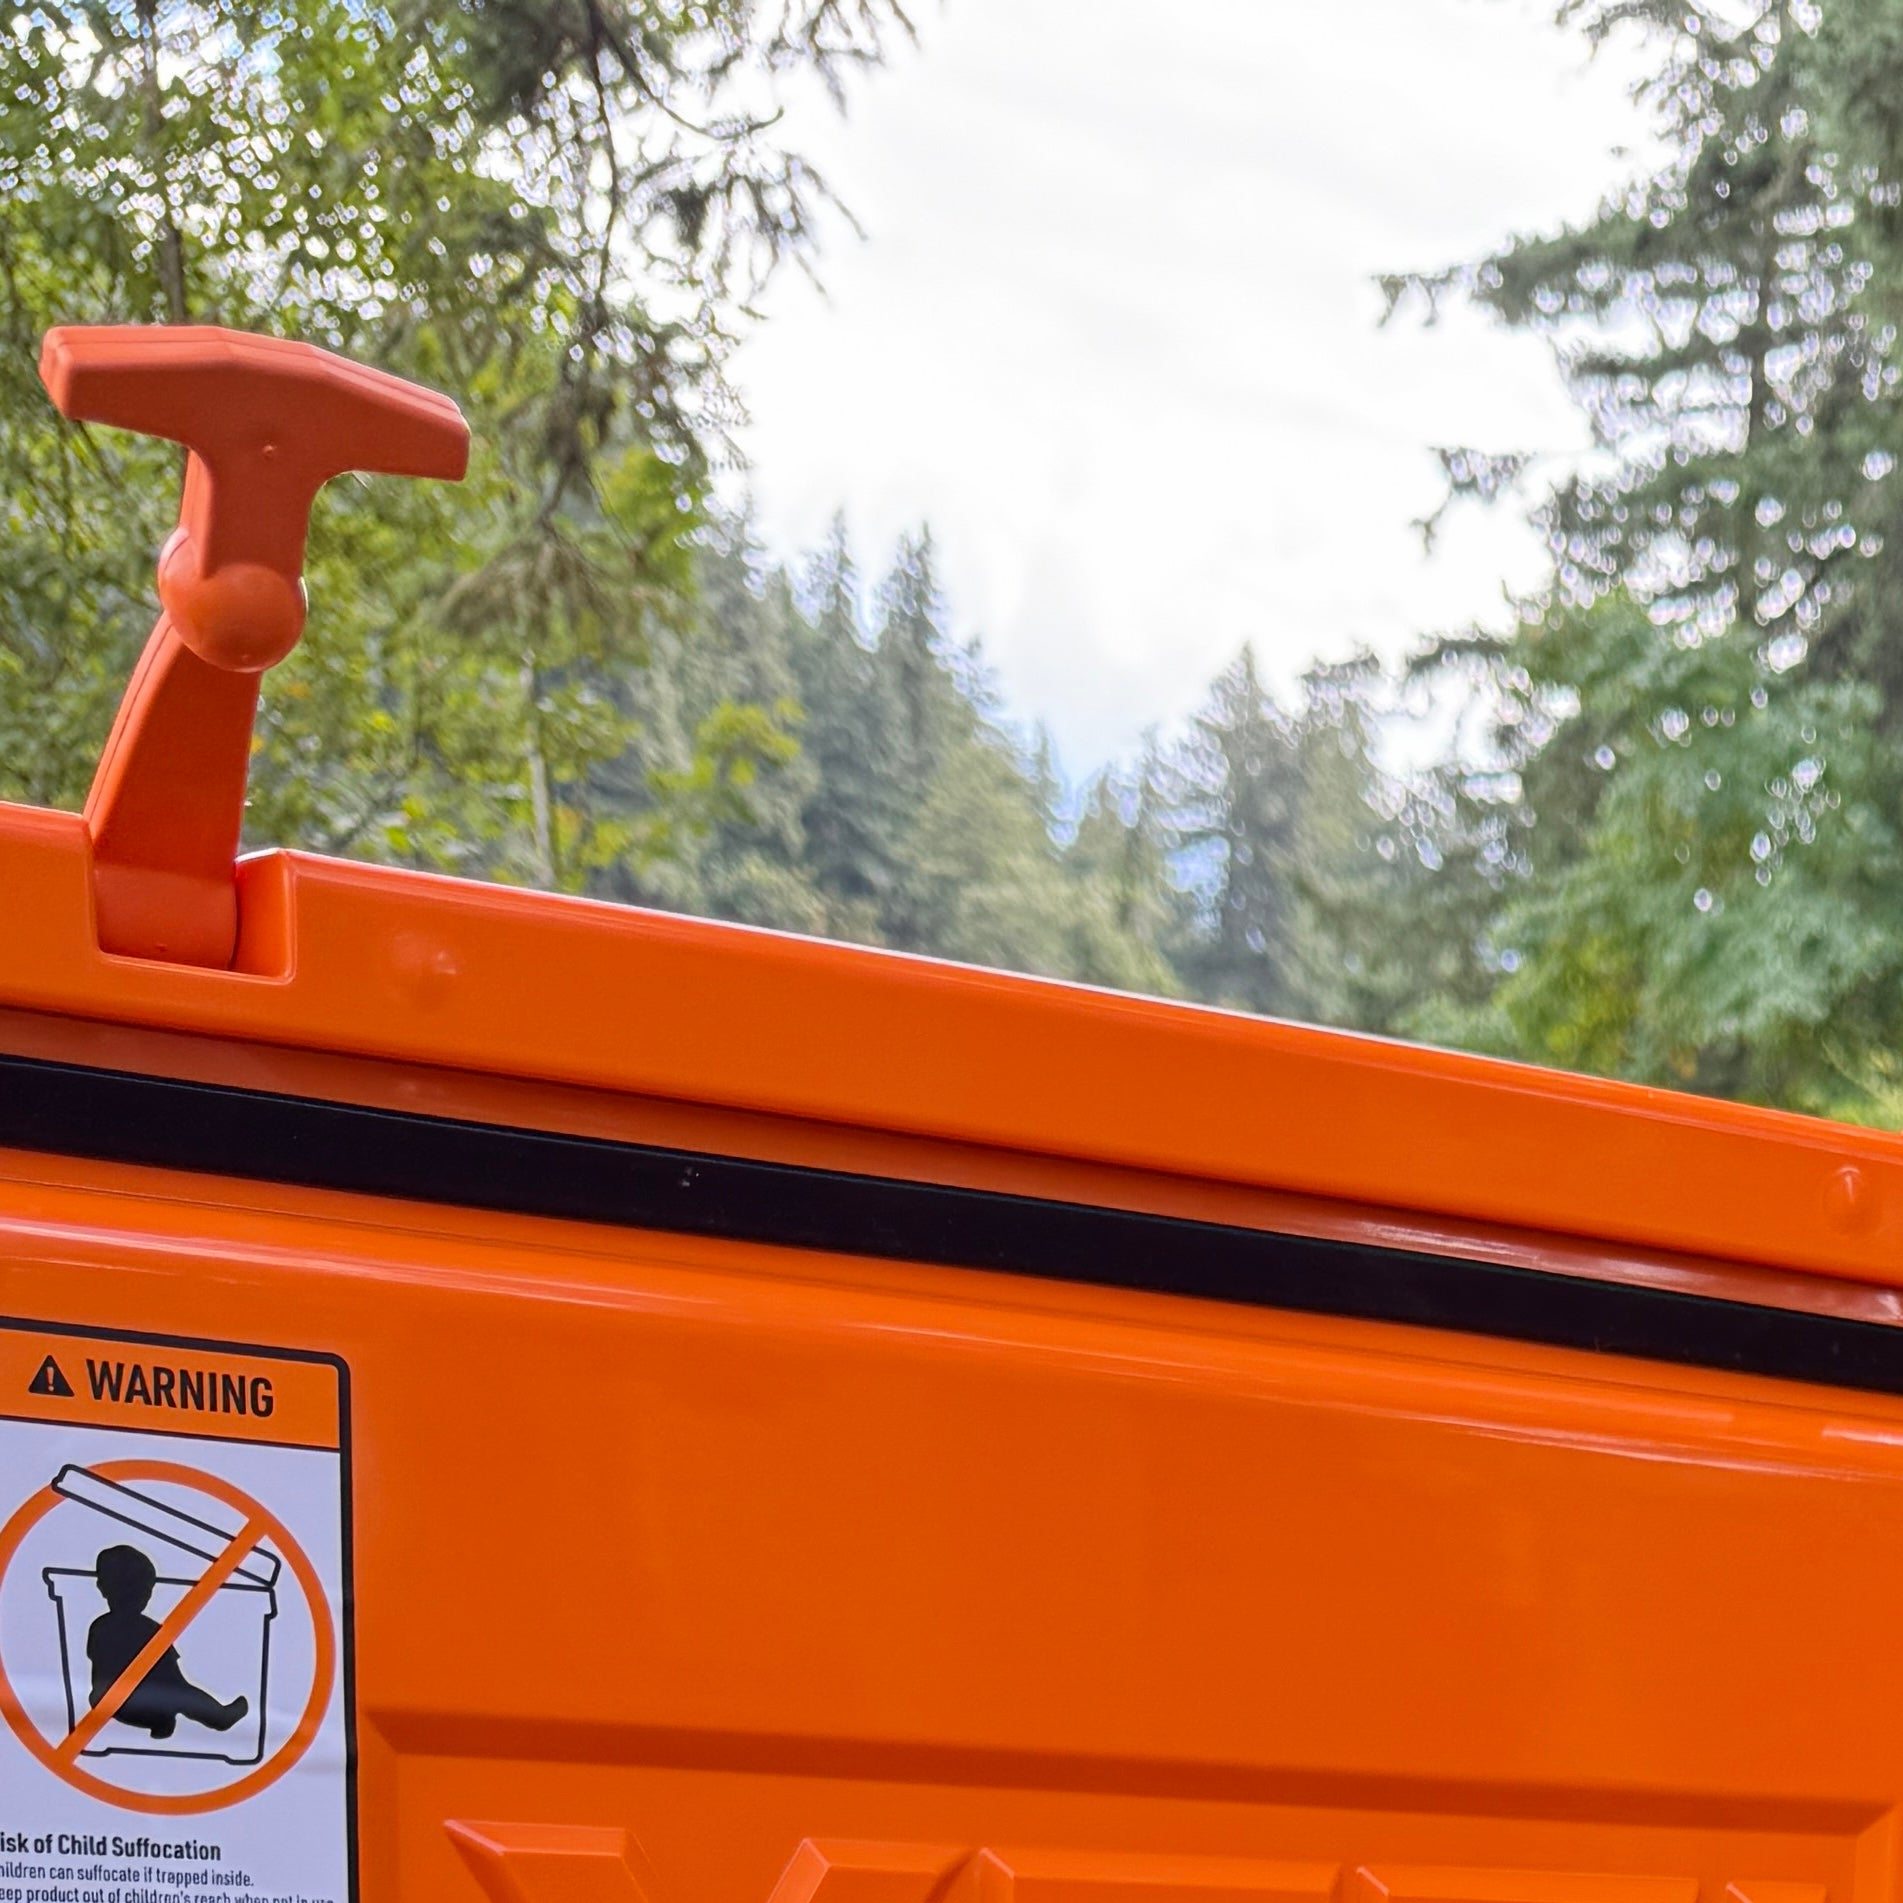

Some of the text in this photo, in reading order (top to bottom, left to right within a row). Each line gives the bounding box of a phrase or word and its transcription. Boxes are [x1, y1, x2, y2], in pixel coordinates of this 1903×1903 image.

[86, 1358, 274, 1418] WARNING
[0, 1831, 221, 1860] isk of Child Suffocation
[0, 1862, 254, 1888] ildren can suffocate if trapped inside.
[0, 1888, 22, 1903] eep
[83, 1889, 104, 1903] out
[108, 1888, 120, 1903] of
